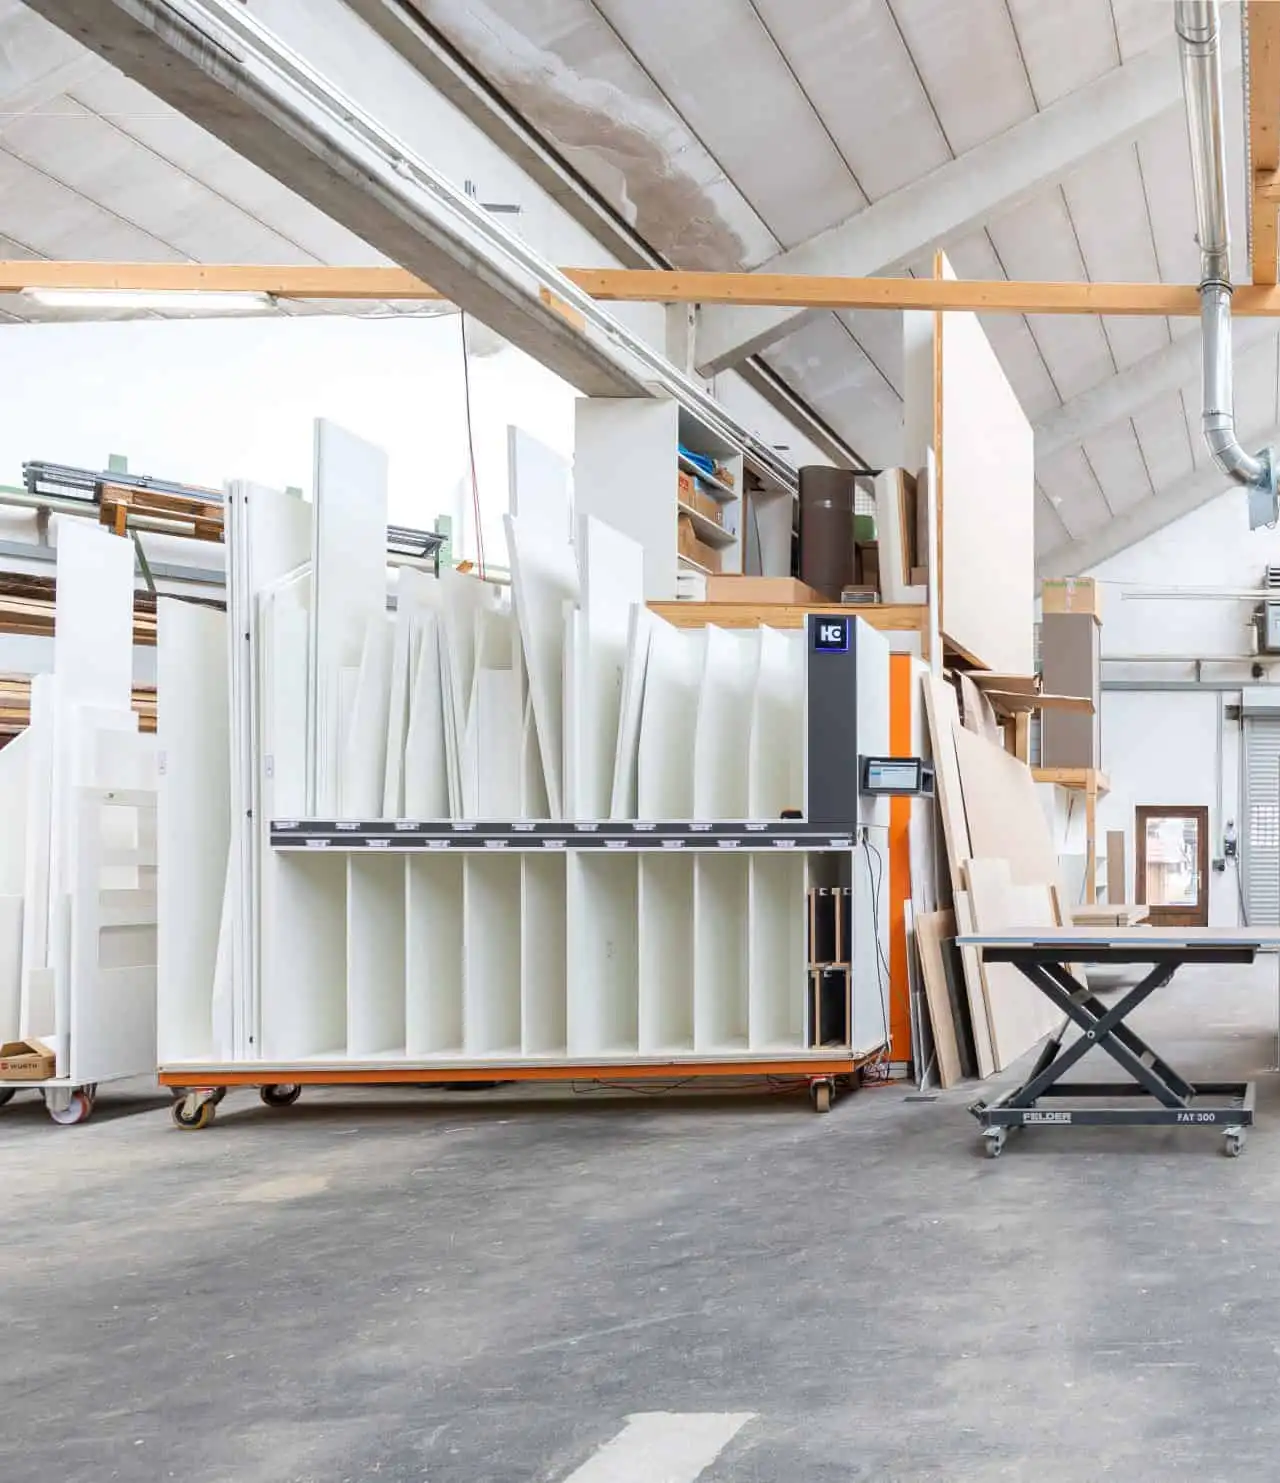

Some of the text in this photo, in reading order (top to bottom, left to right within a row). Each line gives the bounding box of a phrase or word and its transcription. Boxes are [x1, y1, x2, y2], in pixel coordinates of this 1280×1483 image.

[1023, 1112, 1072, 1121] FELDER
[1177, 1112, 1216, 1122] FAT 300
